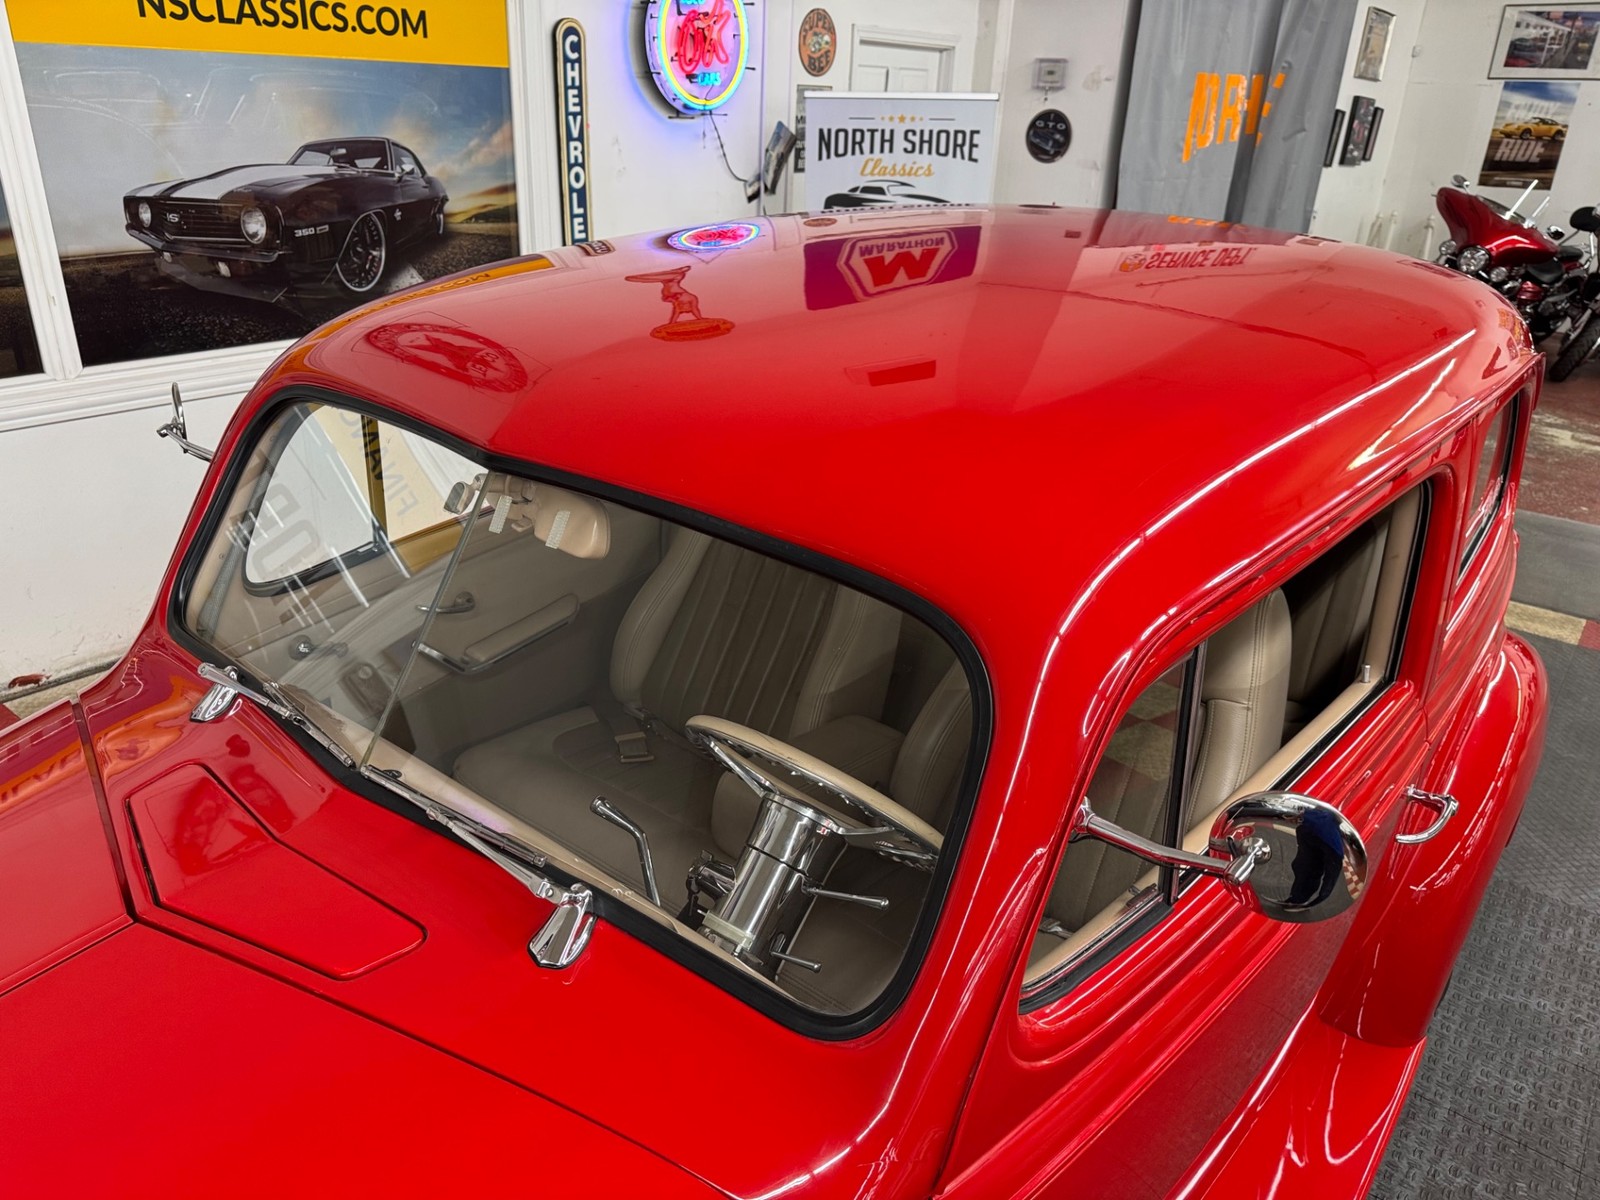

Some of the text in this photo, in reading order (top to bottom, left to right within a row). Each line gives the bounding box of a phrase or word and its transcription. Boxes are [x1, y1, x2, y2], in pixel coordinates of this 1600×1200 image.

[137, 0, 428, 39] NSCLASSICS.COM
[808, 49, 831, 73] BEE
[1035, 119, 1066, 130] GTO
[564, 34, 587, 243] CHEVROLE
[818, 127, 895, 162] NORTH
[903, 129, 981, 163] SHORE
[1494, 138, 1545, 163] RIDE
[860, 157, 934, 177] Classics
